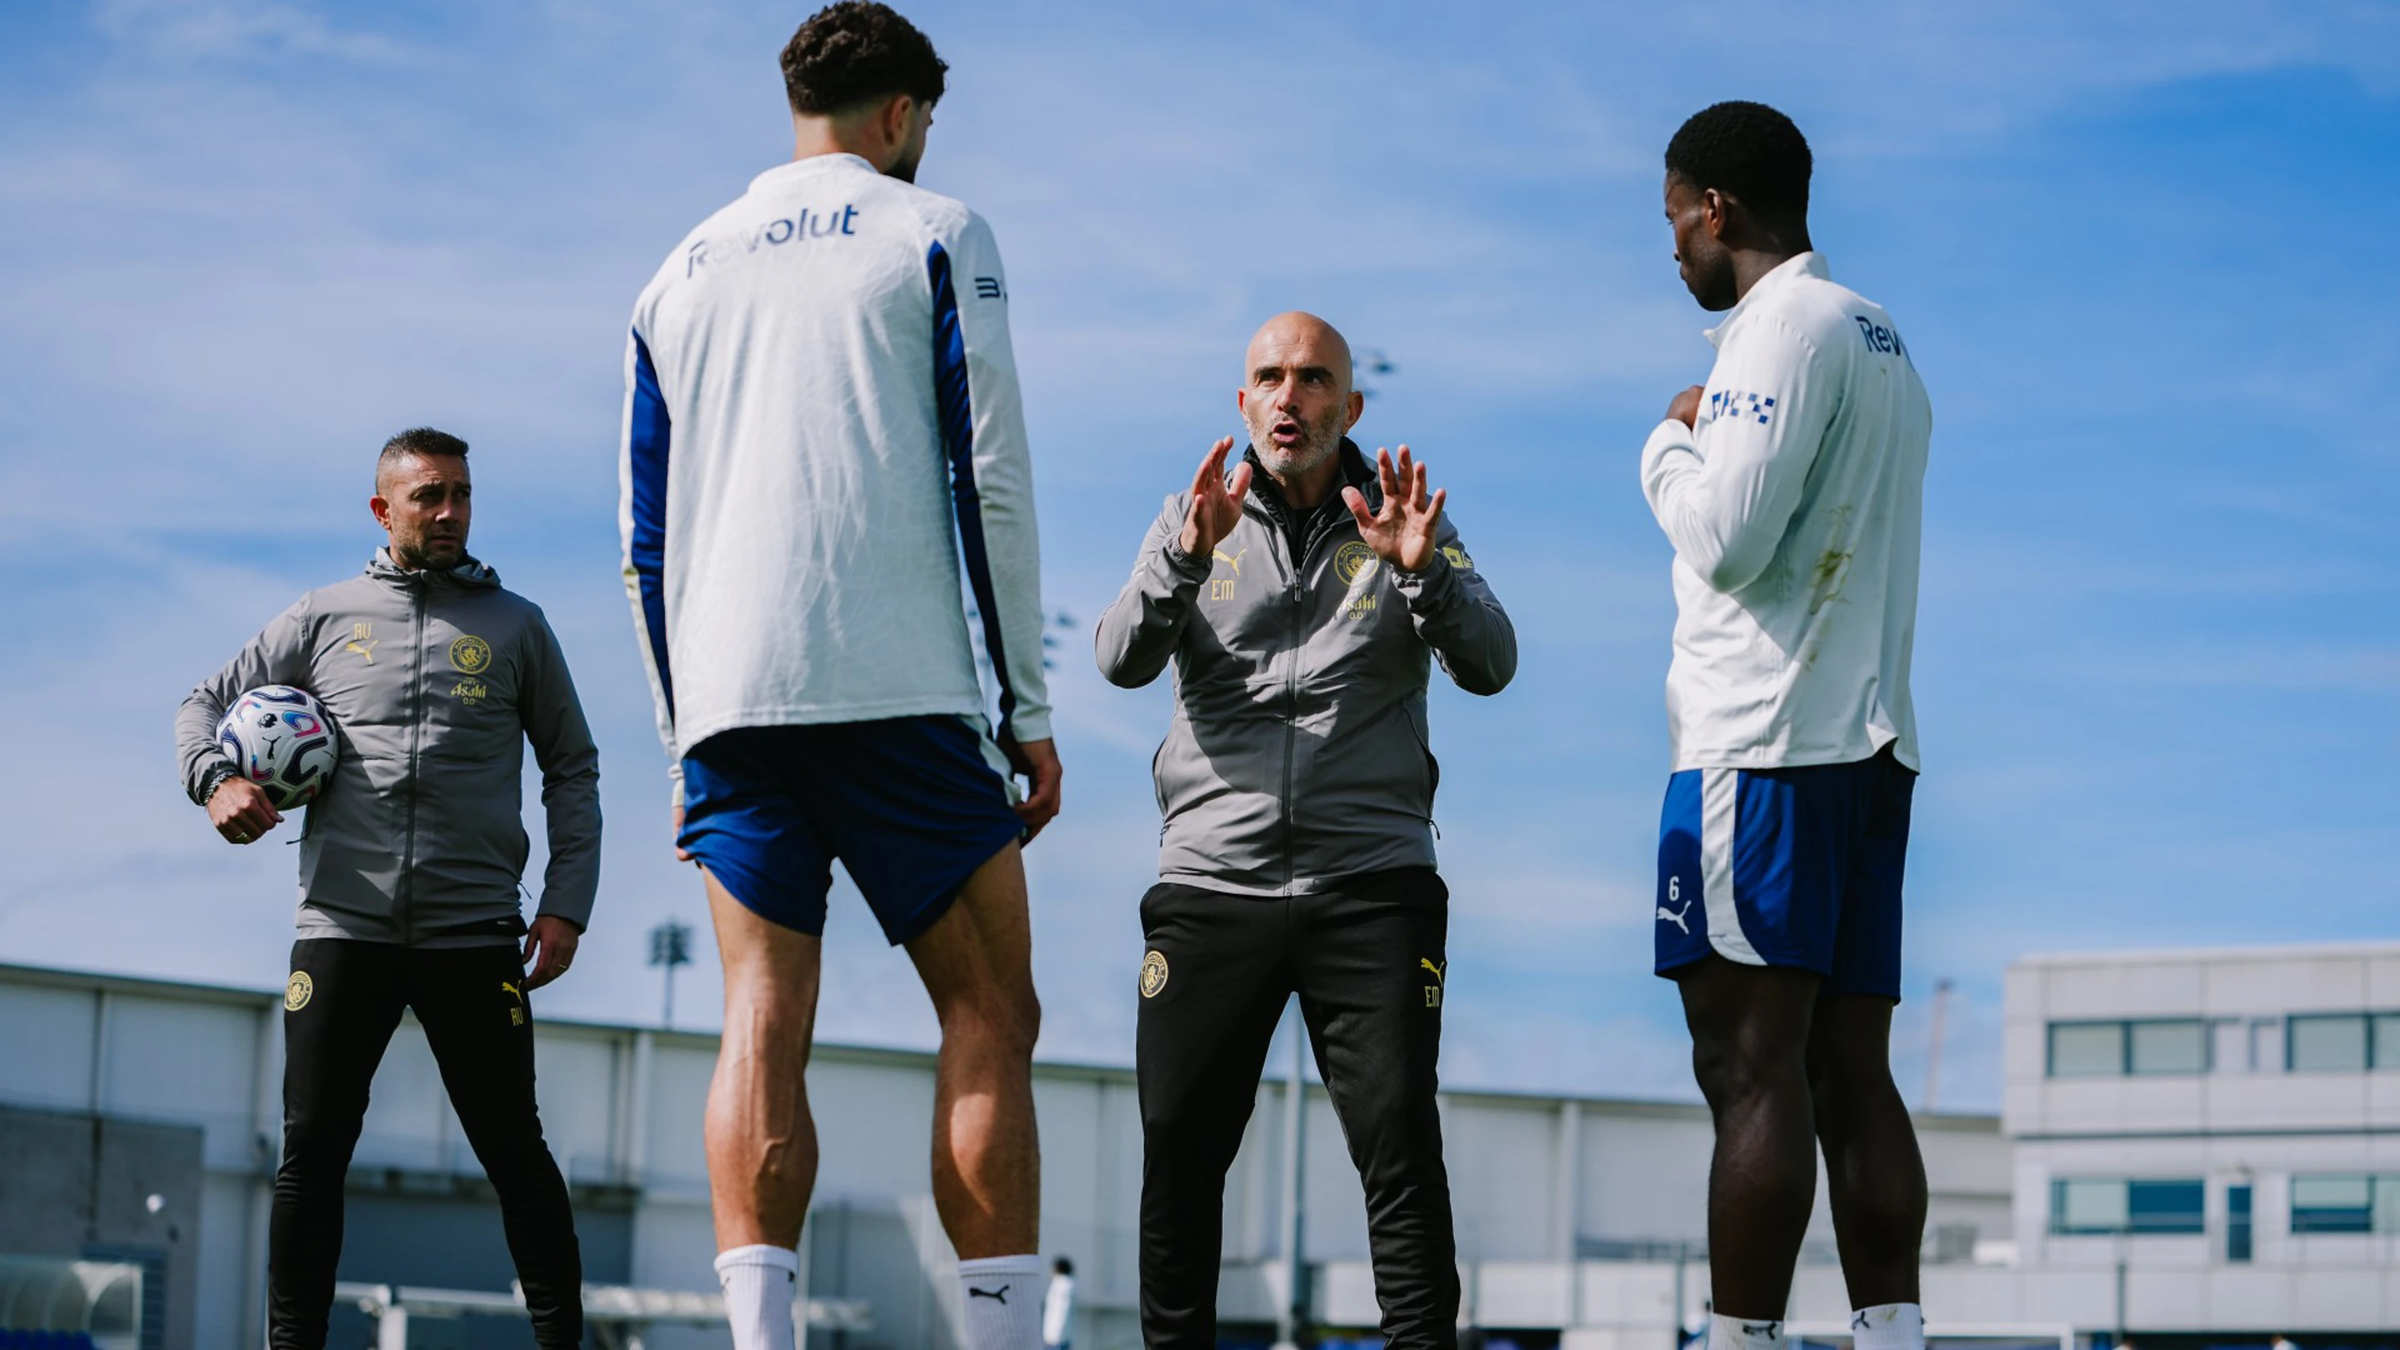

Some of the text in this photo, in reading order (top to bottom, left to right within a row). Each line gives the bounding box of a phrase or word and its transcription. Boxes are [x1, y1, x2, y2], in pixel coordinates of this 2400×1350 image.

[687, 204, 859, 279] Revolut
[1855, 316, 1915, 371] Rev
[1211, 579, 1234, 600] EM
[1346, 594, 1376, 610] sahi
[354, 622, 371, 640] RU
[450, 683, 487, 699] Asahi
[1669, 876, 1680, 902] 6
[1424, 986, 1440, 1007] EM
[510, 1006, 524, 1026] RU
